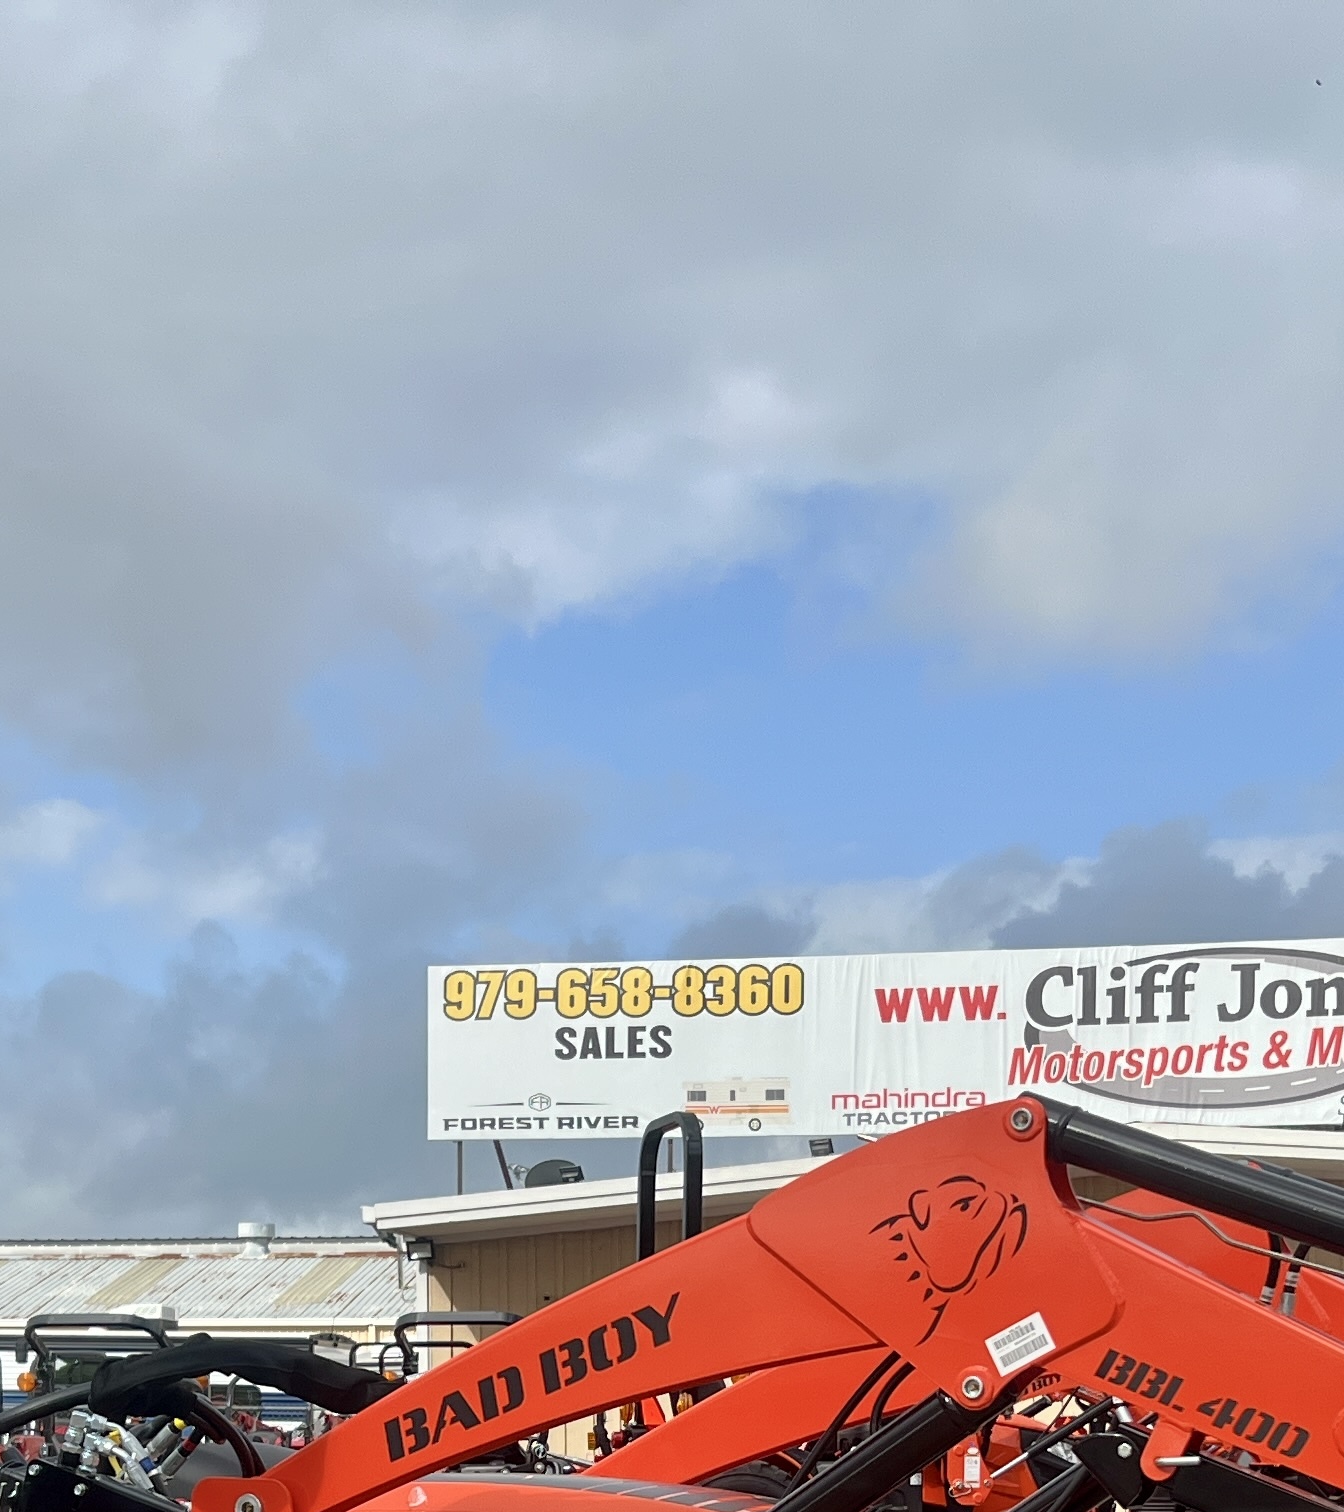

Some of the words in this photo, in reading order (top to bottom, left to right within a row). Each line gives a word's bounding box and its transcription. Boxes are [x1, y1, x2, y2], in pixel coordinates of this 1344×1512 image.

[442, 962, 805, 1022] 979-658-8360
[1024, 961, 1201, 1028] Cliff
[554, 1025, 674, 1061] SALES
[1007, 1034, 1252, 1087] Motorsports
[1262, 1030, 1294, 1070] &
[442, 1116, 551, 1133] FOREST
[555, 1114, 640, 1131] RIVER
[831, 1086, 987, 1110] mahindra
[383, 1364, 527, 1463] BAD
[538, 1291, 681, 1395] BOY
[1093, 1348, 1185, 1413] BBL
[1195, 1398, 1312, 1459] 400
